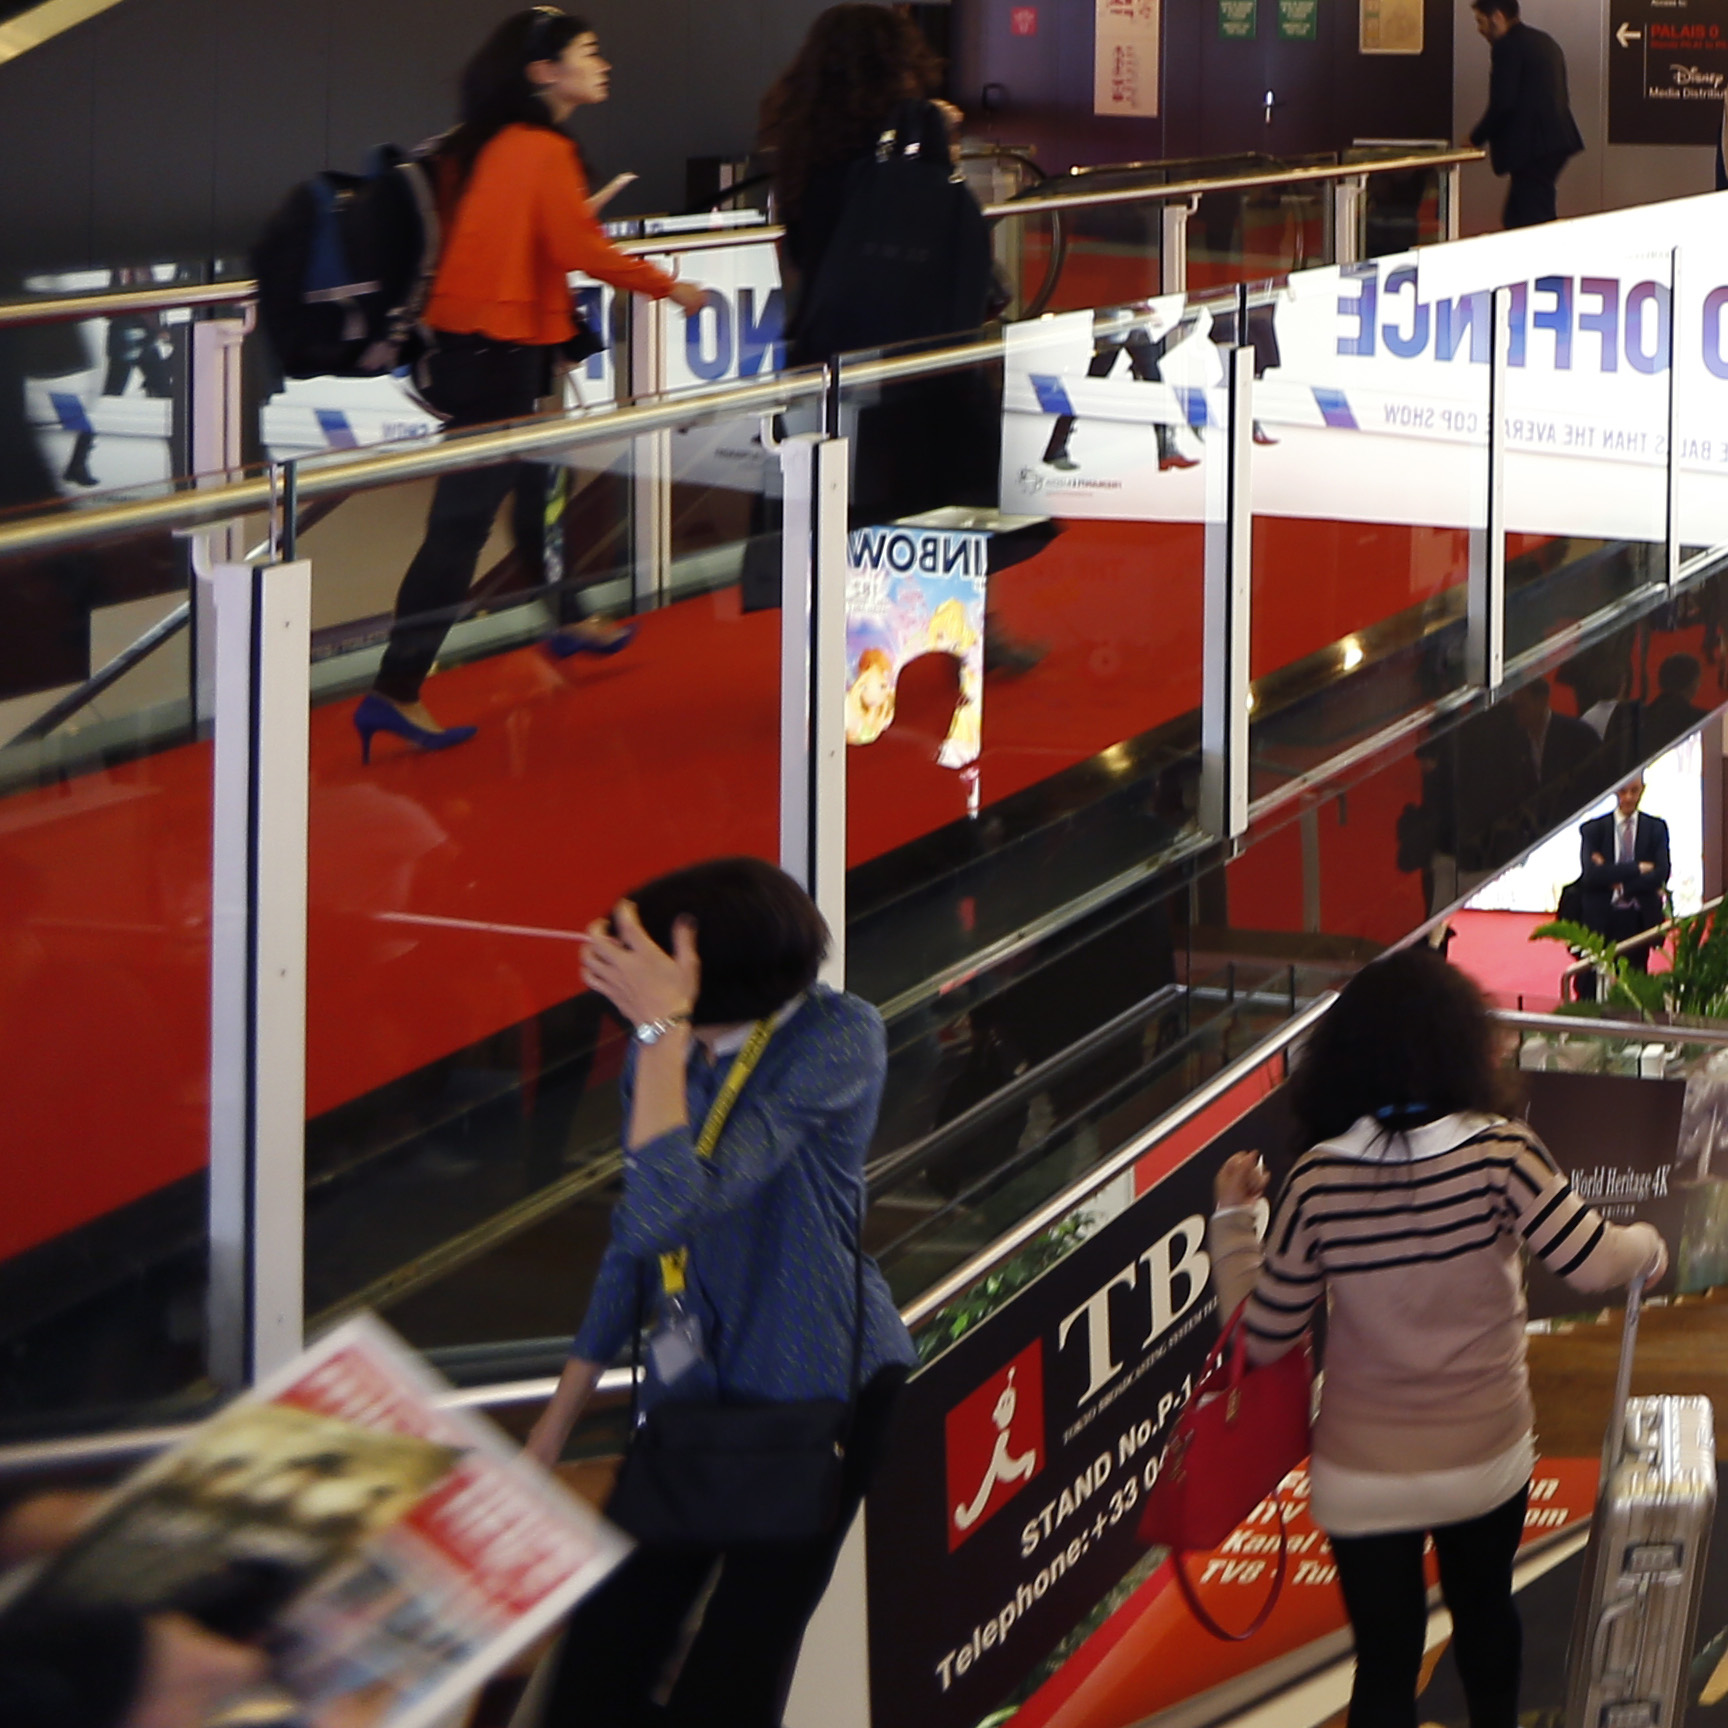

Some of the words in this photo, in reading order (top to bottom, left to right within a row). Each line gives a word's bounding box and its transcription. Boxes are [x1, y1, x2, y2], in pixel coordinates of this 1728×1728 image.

[1650, 24, 1706, 39] PALAIS
[1669, 63, 1724, 89] Disney
[1649, 86, 1681, 99] Media
[1571, 1165, 1605, 1198] World
[1605, 1165, 1652, 1203] Heritage
[1651, 1163, 1672, 1199] 4K
[1058, 1197, 1271, 1410] TB
[1020, 1450, 1113, 1559] STAND
[1221, 1530, 1318, 1555] Kanal
[1200, 1559, 1267, 1586] TV8
